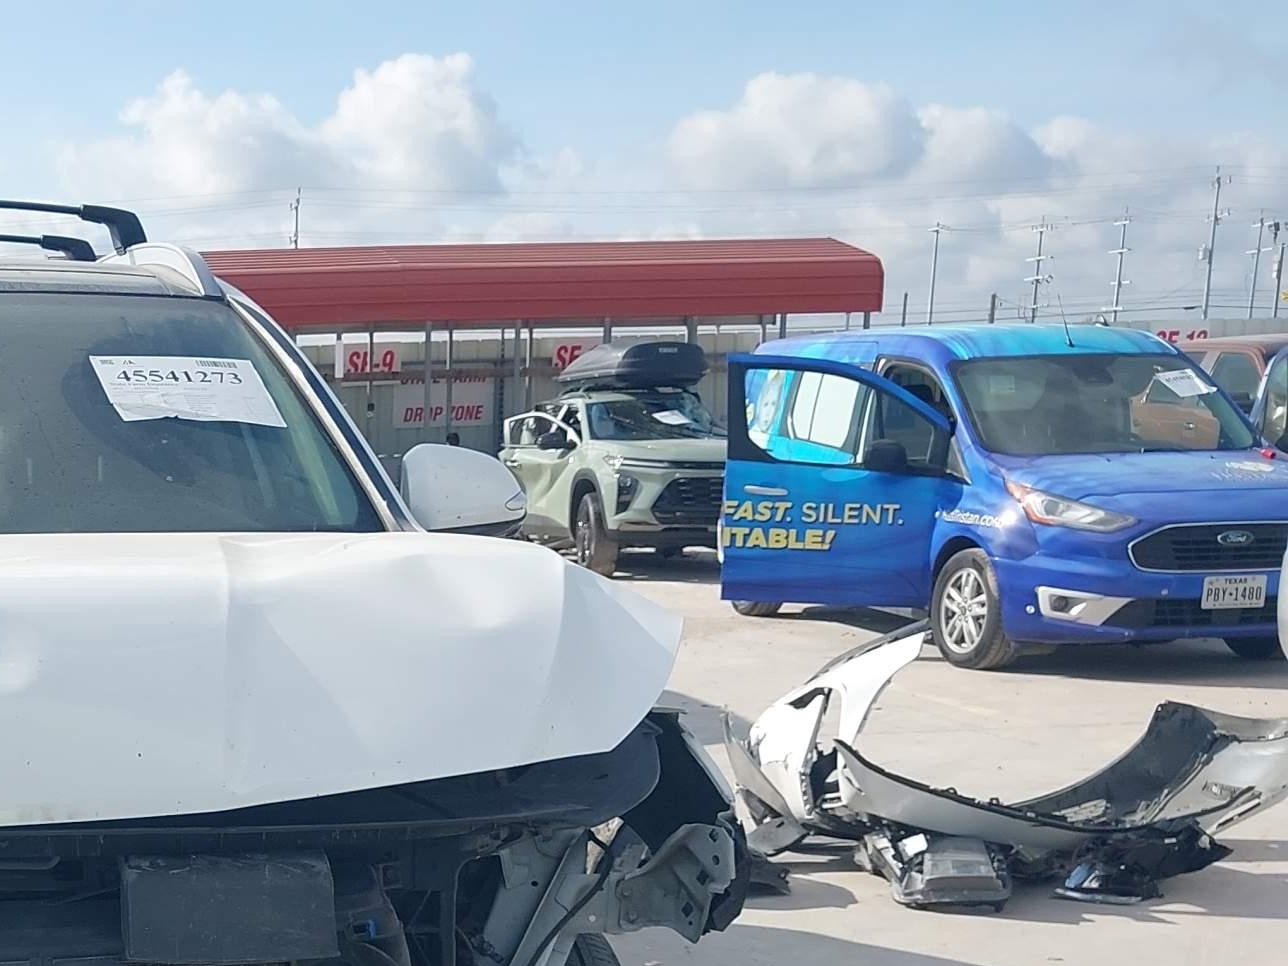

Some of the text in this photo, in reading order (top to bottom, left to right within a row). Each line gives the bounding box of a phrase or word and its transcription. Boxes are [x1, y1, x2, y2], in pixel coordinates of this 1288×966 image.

[117, 369, 243, 385] 45541273
[403, 405, 444, 423] DRP
[723, 500, 905, 525] FAST. SILENT.
[1224, 577, 1248, 585] TEXAS
